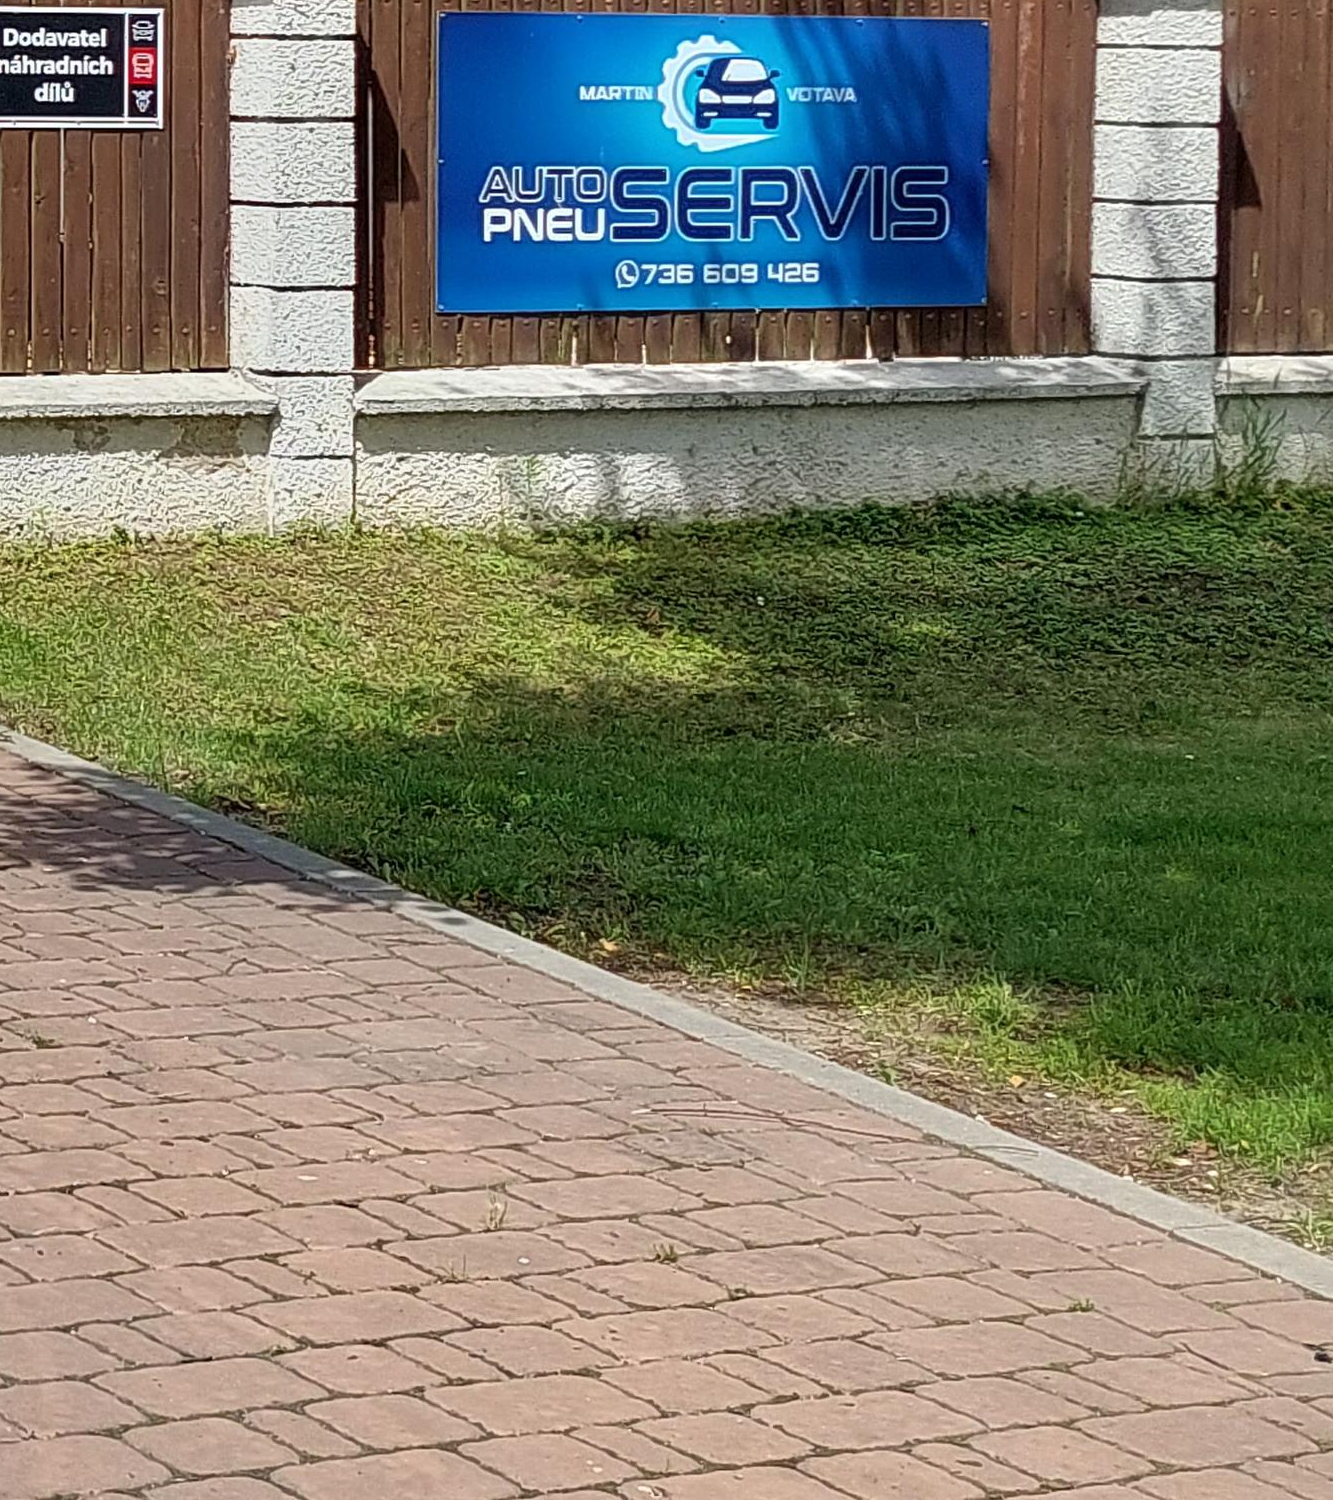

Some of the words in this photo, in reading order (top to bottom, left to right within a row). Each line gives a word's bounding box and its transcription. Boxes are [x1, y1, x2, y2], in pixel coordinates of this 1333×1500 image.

[2, 27, 108, 48] Dodavatel
[33, 81, 75, 103] dílů
[579, 85, 654, 101] MARTIN
[786, 86, 858, 103] VOTAVA
[479, 165, 607, 203] AUTO
[608, 164, 950, 243] SERVIS
[482, 207, 607, 243] PNEU
[640, 263, 694, 285] 736
[703, 263, 759, 285] 609
[766, 262, 821, 284] 426
